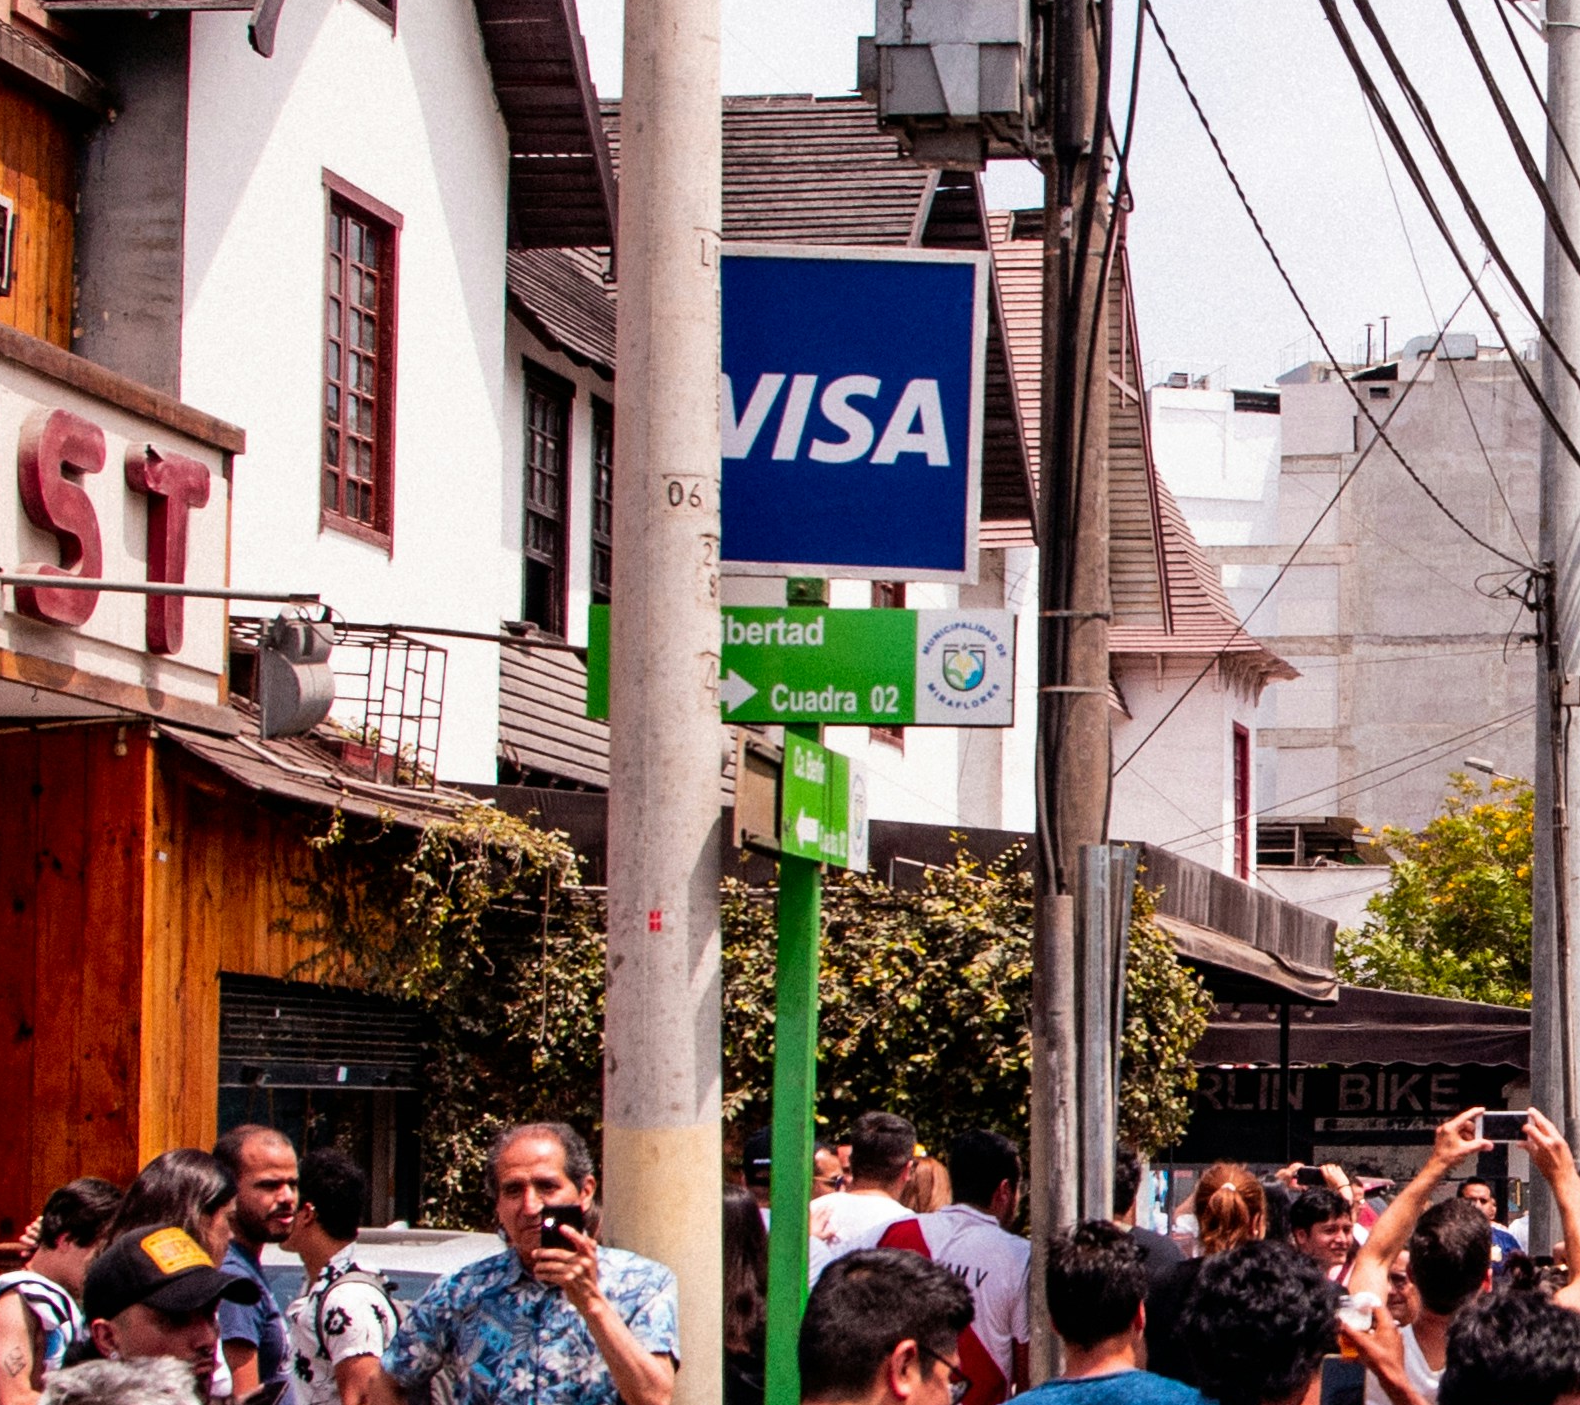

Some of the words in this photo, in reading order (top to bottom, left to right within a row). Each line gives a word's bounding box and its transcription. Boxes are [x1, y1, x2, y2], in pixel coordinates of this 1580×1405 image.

[721, 371, 951, 467] VISA
[721, 615, 824, 646] ibertad
[922, 621, 999, 656] MUNICIPALIDAD
[995, 643, 1008, 658] DE
[771, 684, 857, 713] Cuadra
[870, 686, 900, 713] 02
[927, 682, 1001, 711] MIRAFLORES
[1196, 1071, 1306, 1112] RLIN
[1338, 1071, 1462, 1112] BIKE
